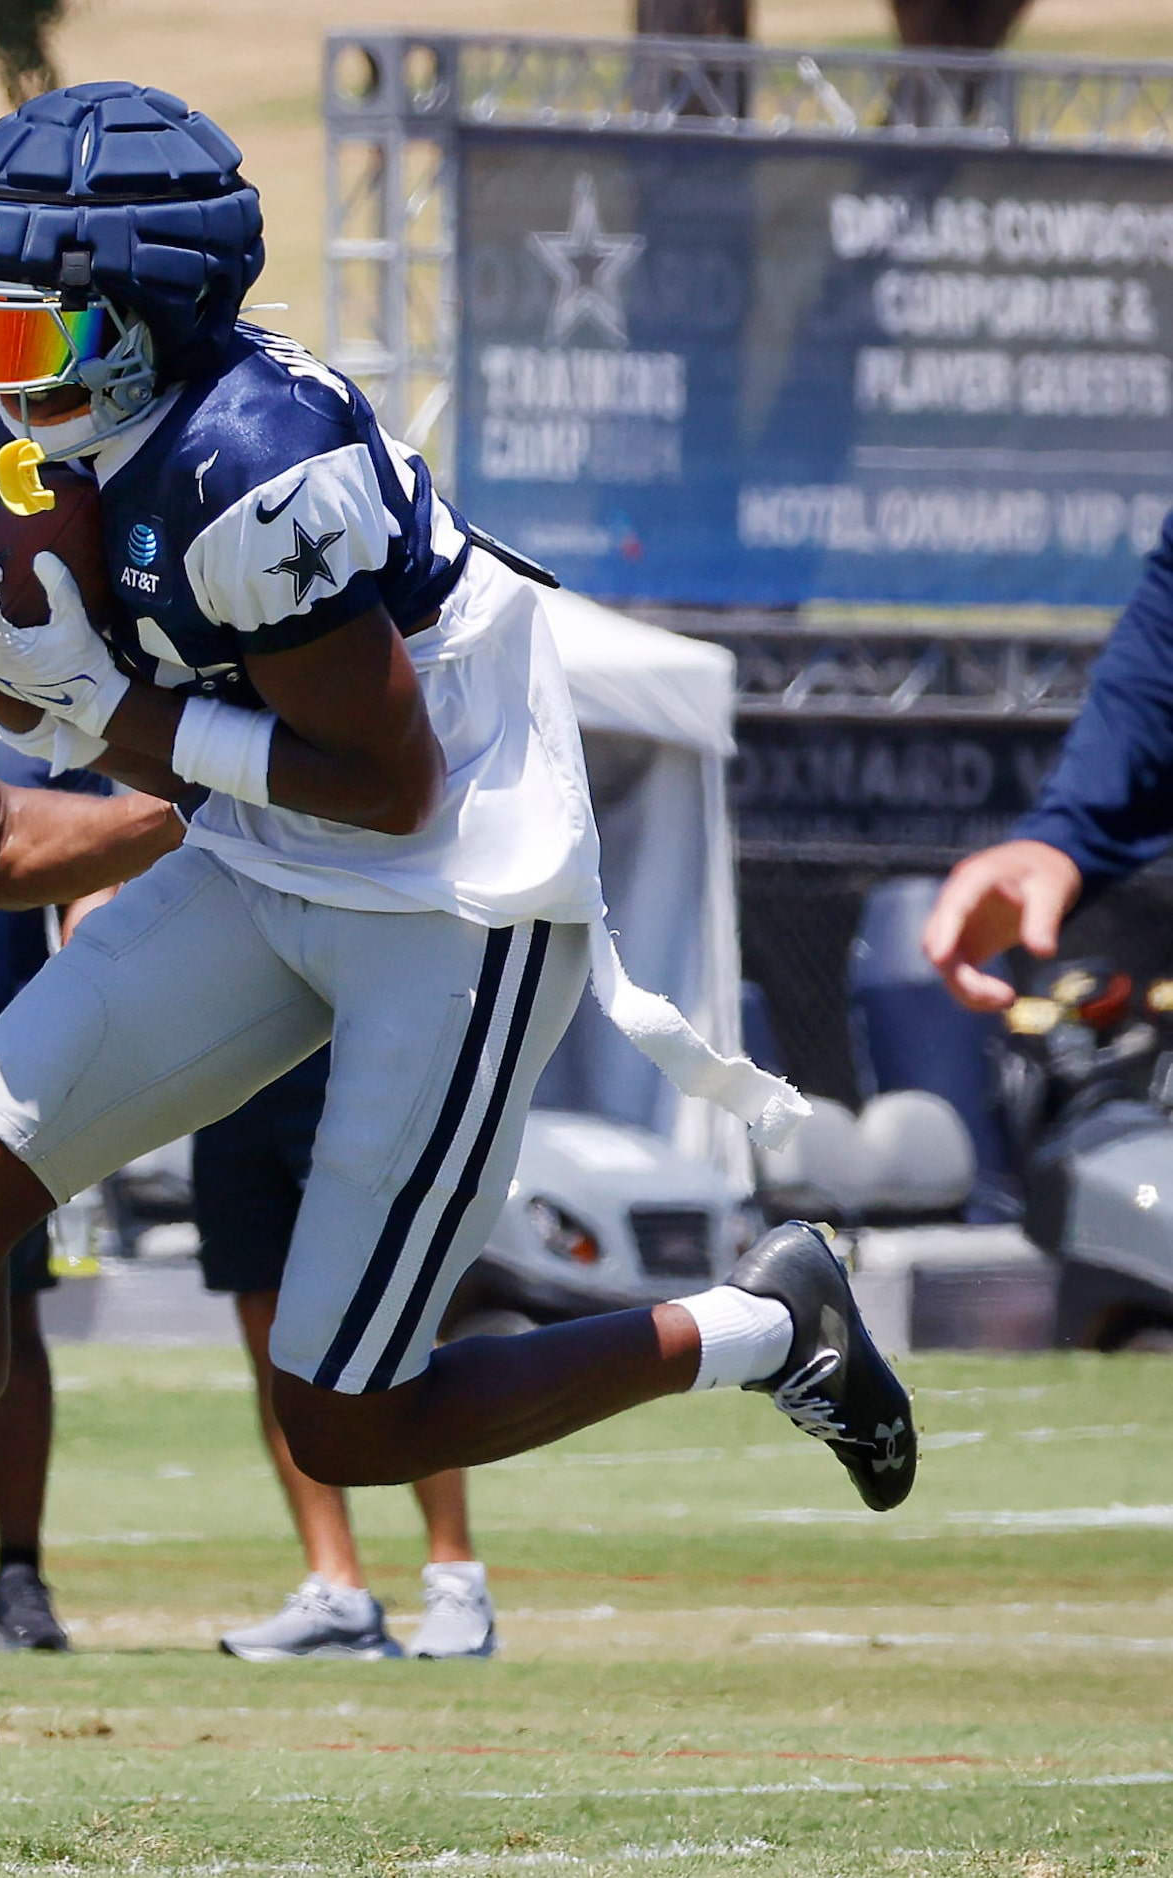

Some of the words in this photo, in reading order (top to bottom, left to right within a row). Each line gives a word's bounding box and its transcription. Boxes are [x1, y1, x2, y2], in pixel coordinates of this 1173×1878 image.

[874, 271, 1116, 339] CORPORATE
[855, 346, 1014, 413] PLAYER
[1018, 351, 1171, 417] GUESTS
[738, 484, 876, 553] HOTEL
[121, 567, 159, 593] AT&T
